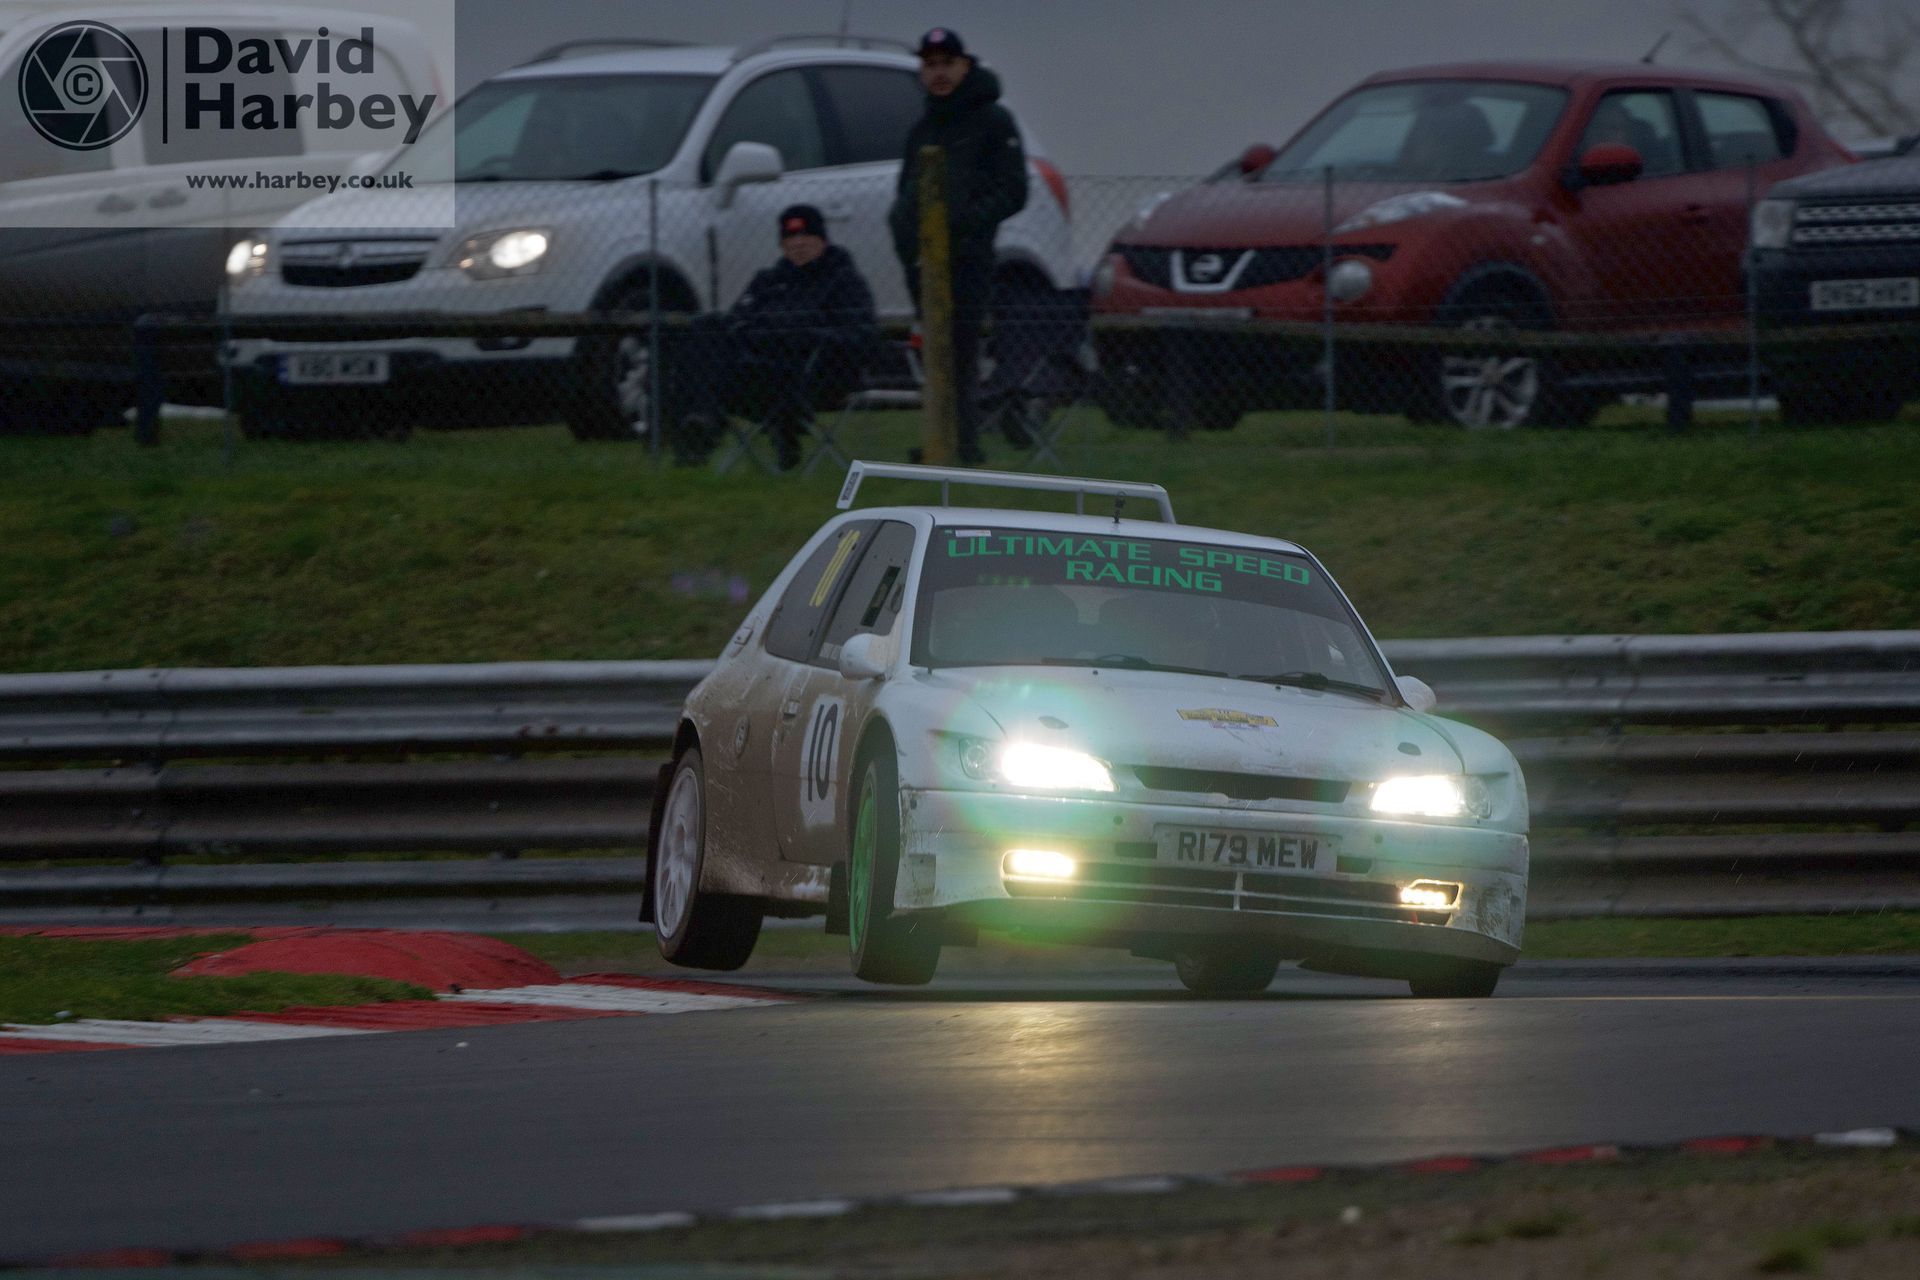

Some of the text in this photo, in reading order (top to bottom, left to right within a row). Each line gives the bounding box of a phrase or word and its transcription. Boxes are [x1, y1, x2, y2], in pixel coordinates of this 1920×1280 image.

[948, 535, 1311, 586] ULTIMATE SPEED
[1066, 560, 1223, 592] RACING
[808, 703, 838, 801] 10
[1178, 831, 1319, 870] R179 MEW
